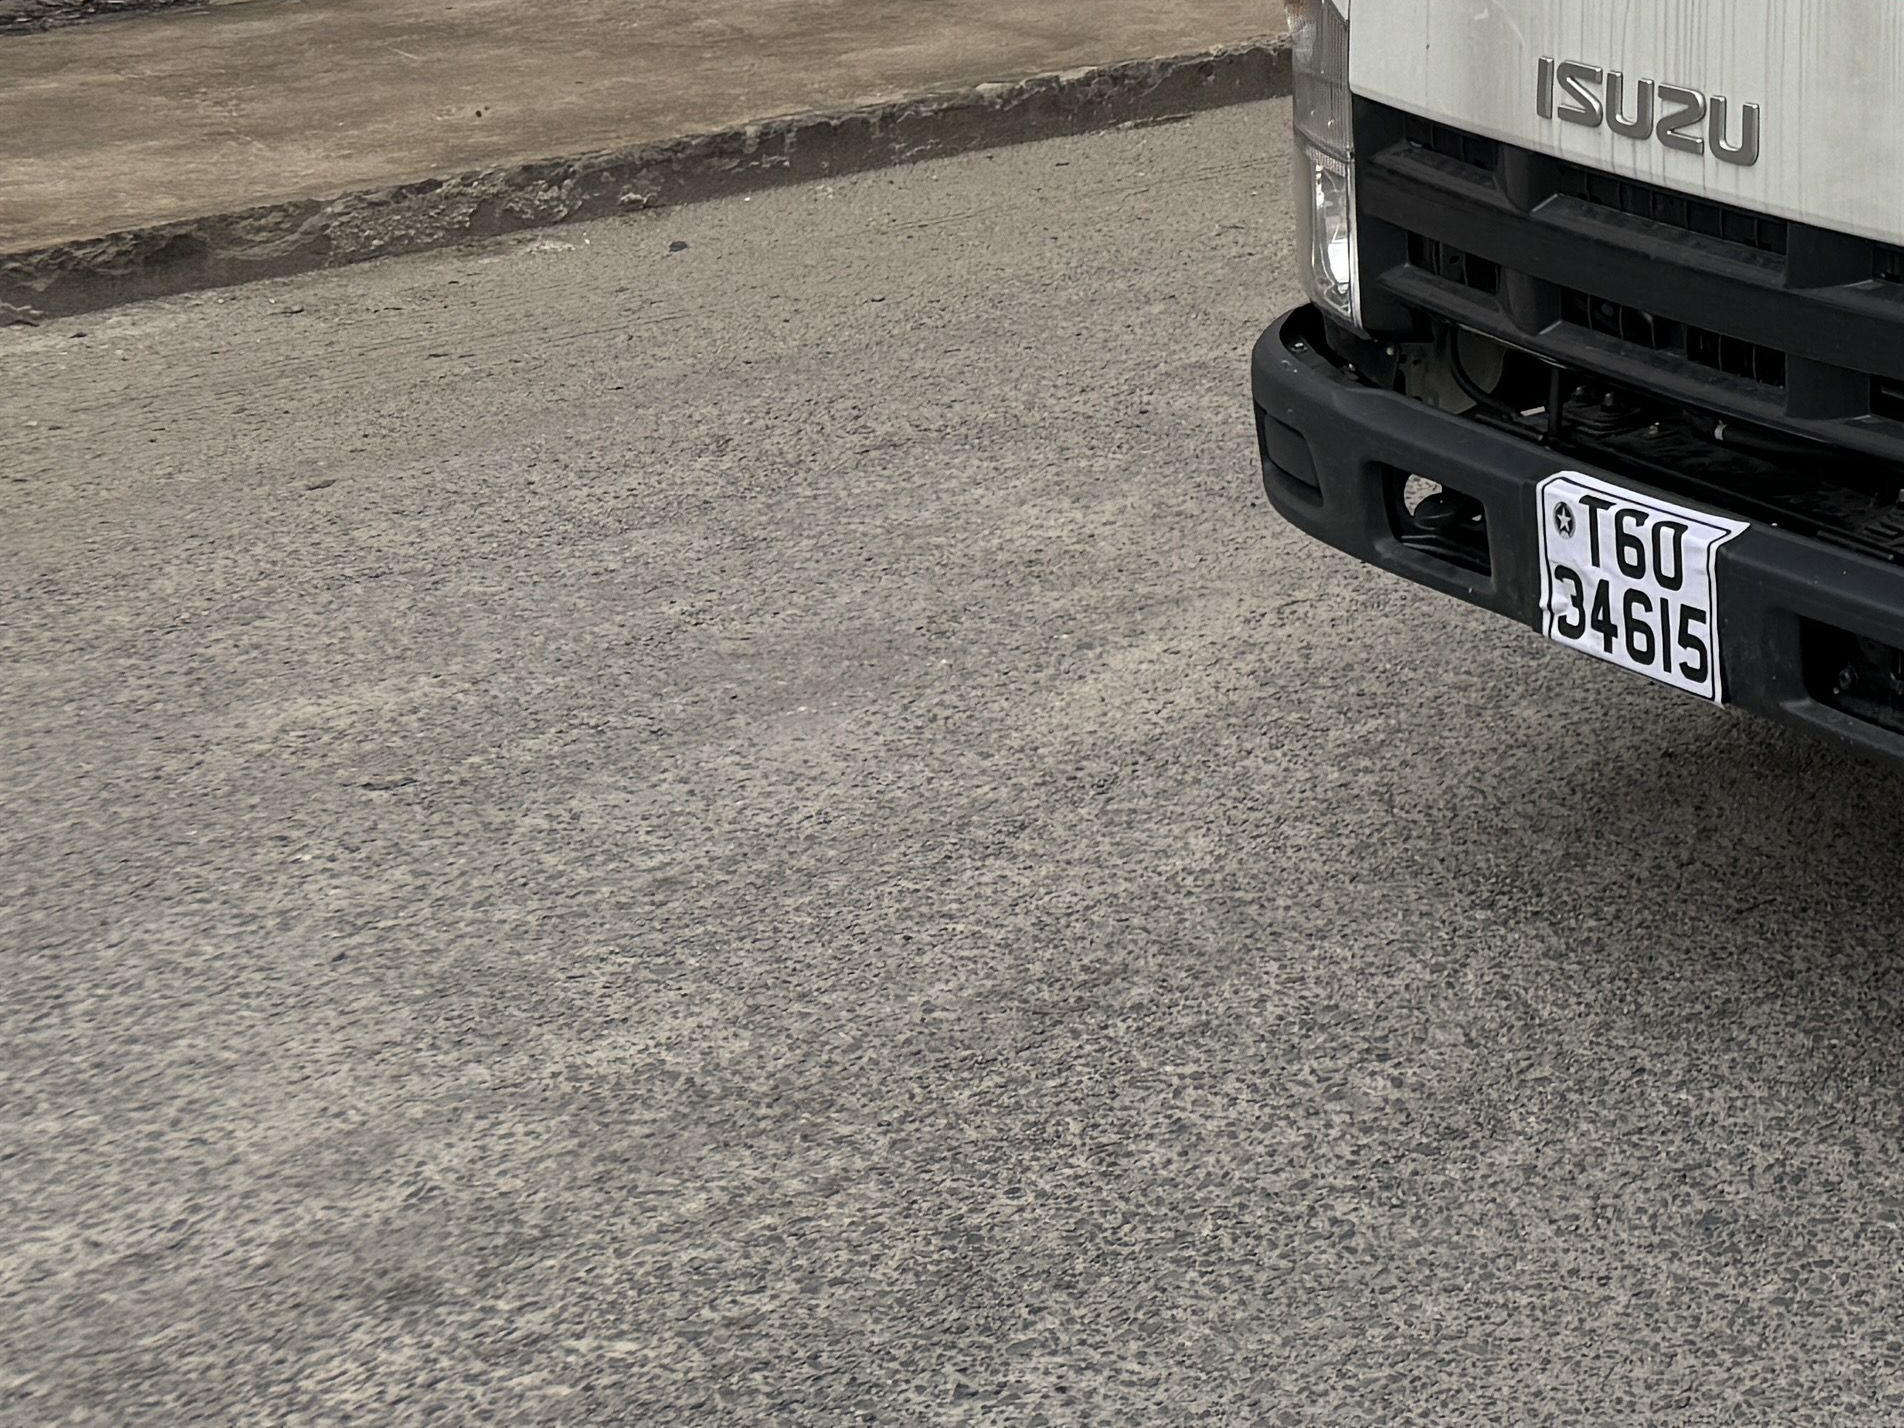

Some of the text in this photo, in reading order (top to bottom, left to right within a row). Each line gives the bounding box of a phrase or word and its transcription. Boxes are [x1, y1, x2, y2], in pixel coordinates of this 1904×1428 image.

[1536, 55, 1760, 167] ISUZU
[1578, 494, 1689, 592] T60
[1554, 564, 1709, 684] 34615
